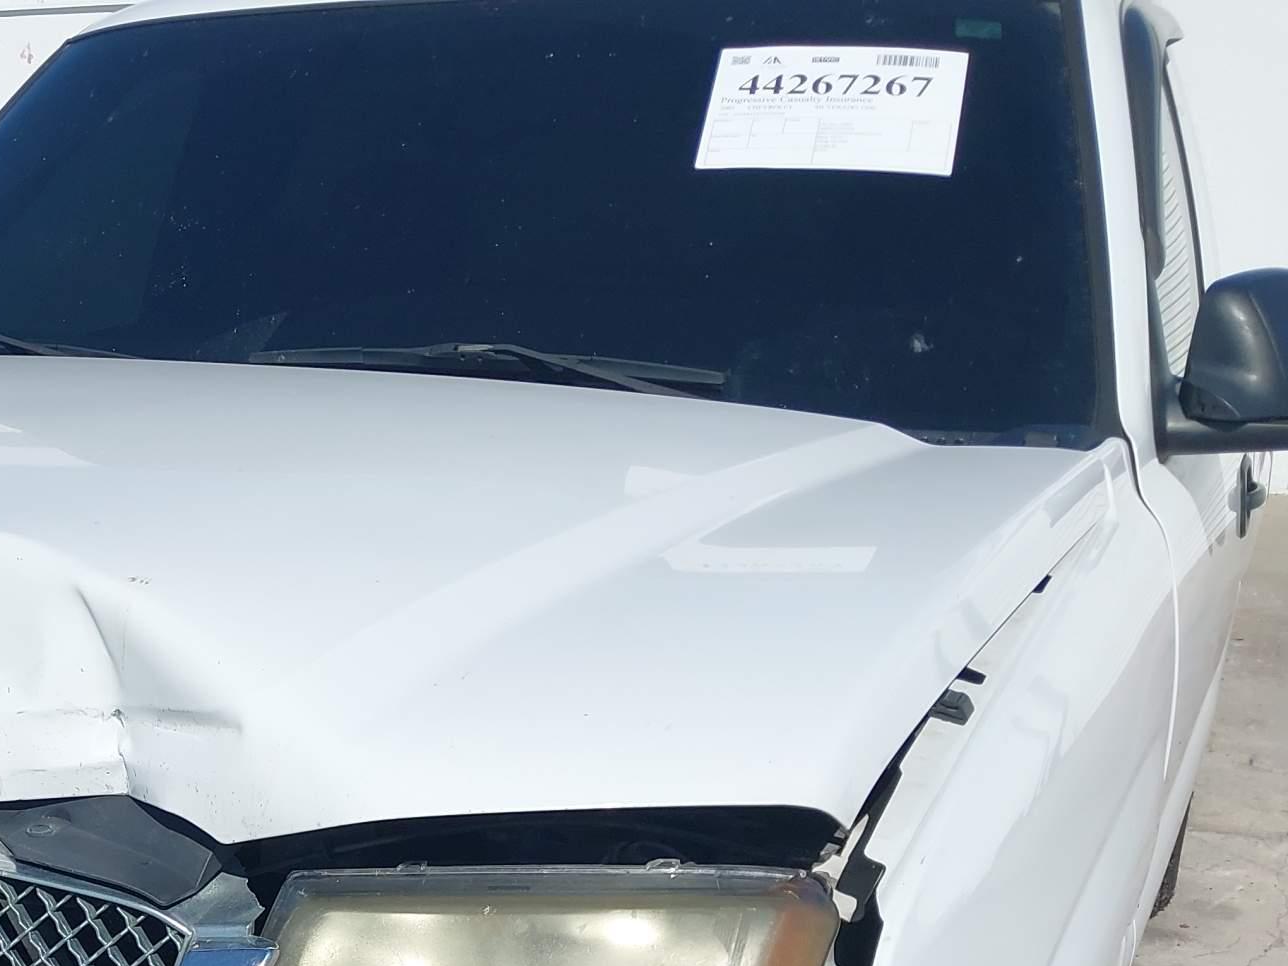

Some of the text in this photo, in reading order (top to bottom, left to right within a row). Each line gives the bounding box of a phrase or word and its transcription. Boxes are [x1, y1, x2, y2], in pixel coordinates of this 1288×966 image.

[738, 74, 933, 97] 44267267
[720, 95, 873, 105] Progressive Casualty Insurance
